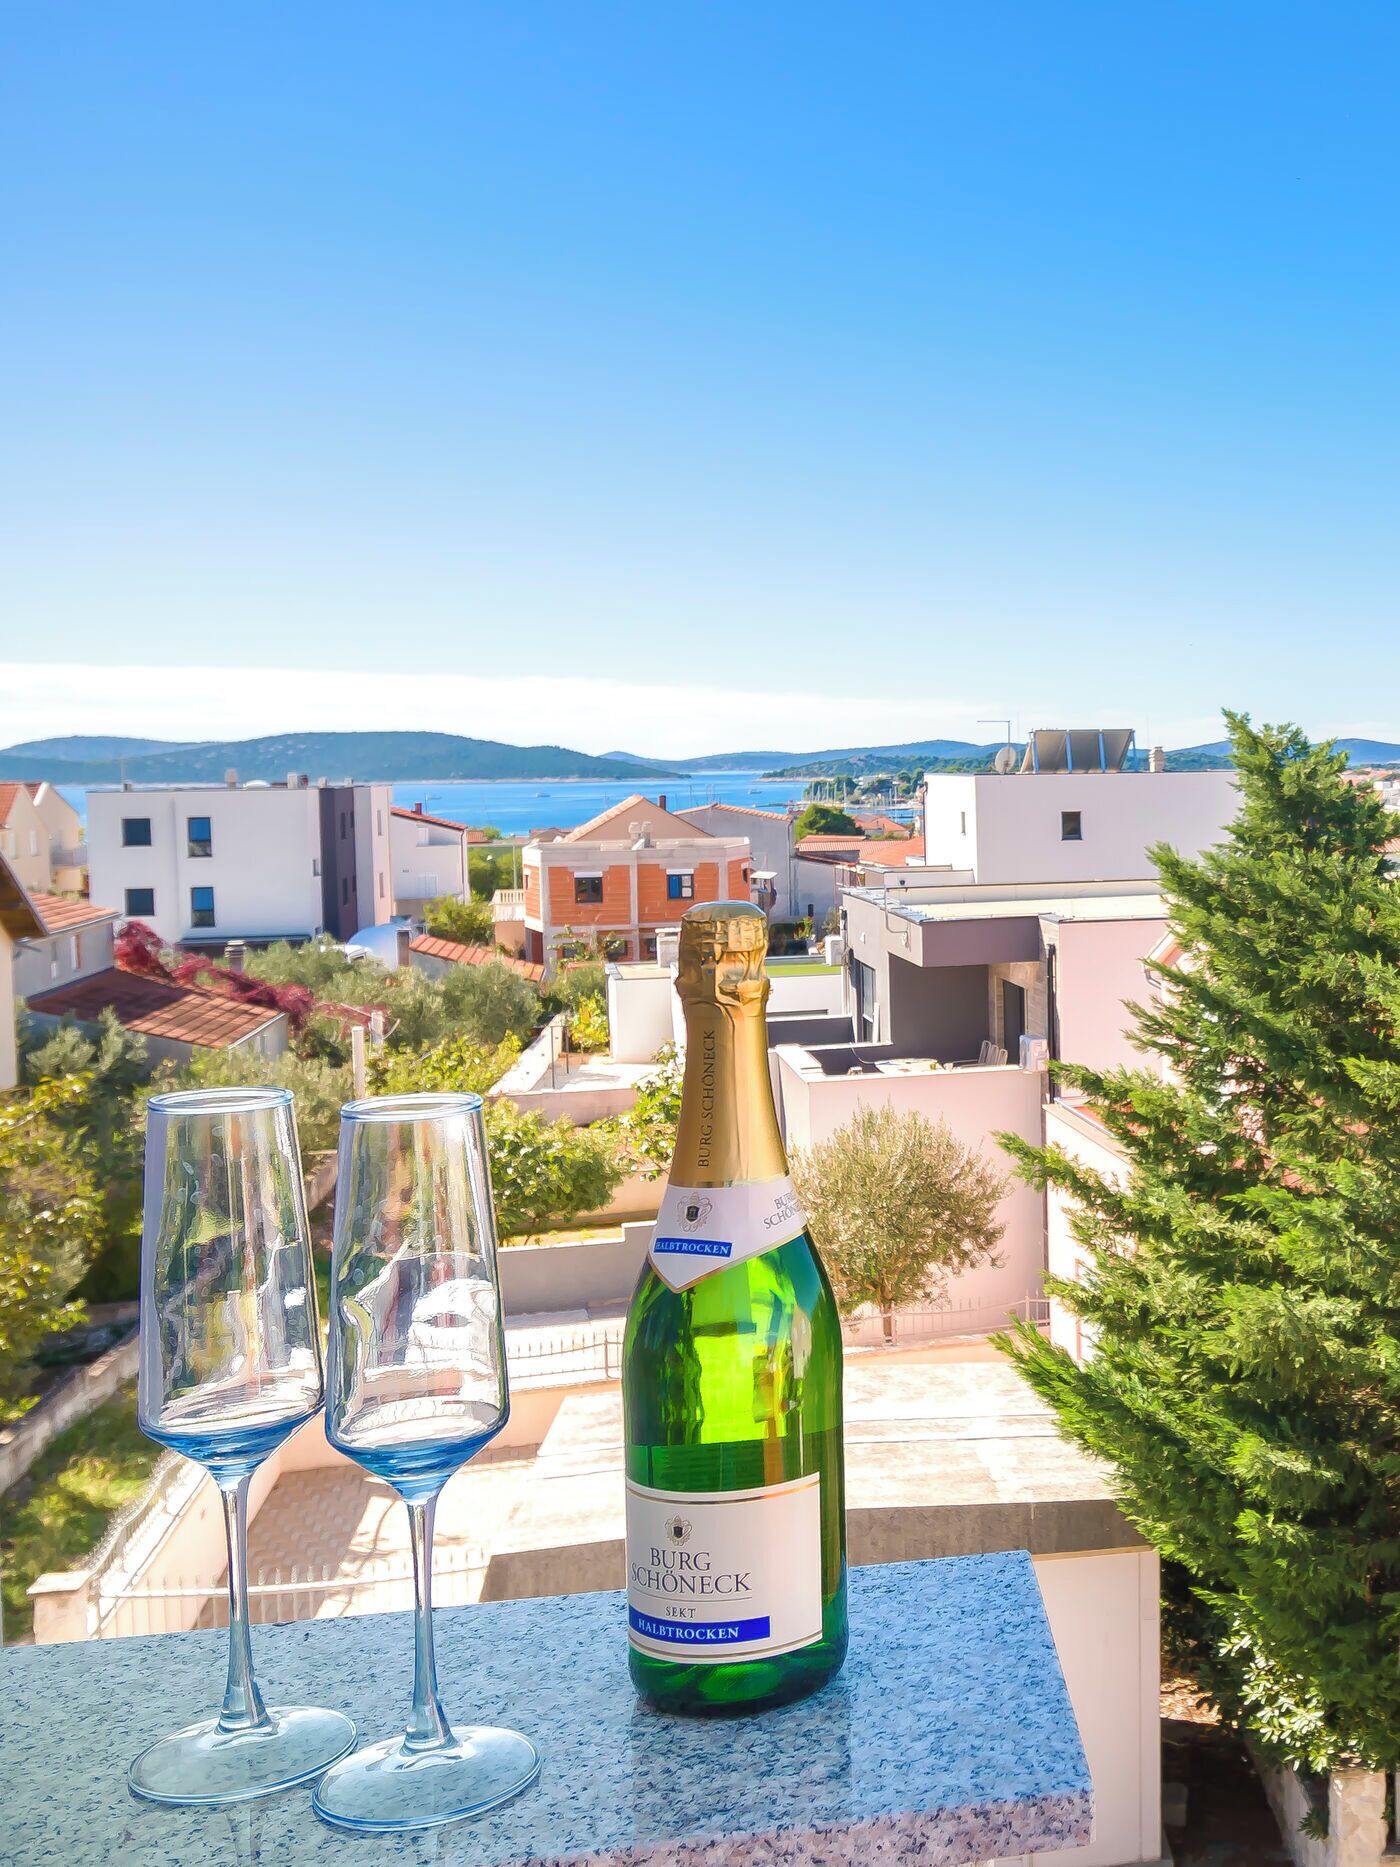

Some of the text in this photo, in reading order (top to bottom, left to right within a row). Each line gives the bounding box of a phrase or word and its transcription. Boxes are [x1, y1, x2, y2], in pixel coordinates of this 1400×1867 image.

[697, 1030, 716, 1168] BURG SCHÖNECK
[655, 1241, 730, 1255] HALBTROCKEN
[650, 1547, 711, 1572] BURG
[631, 1562, 752, 1595] SCHÖNECK
[665, 1606, 697, 1619] SEKT
[638, 1618, 739, 1641] HALBTROCKEN
